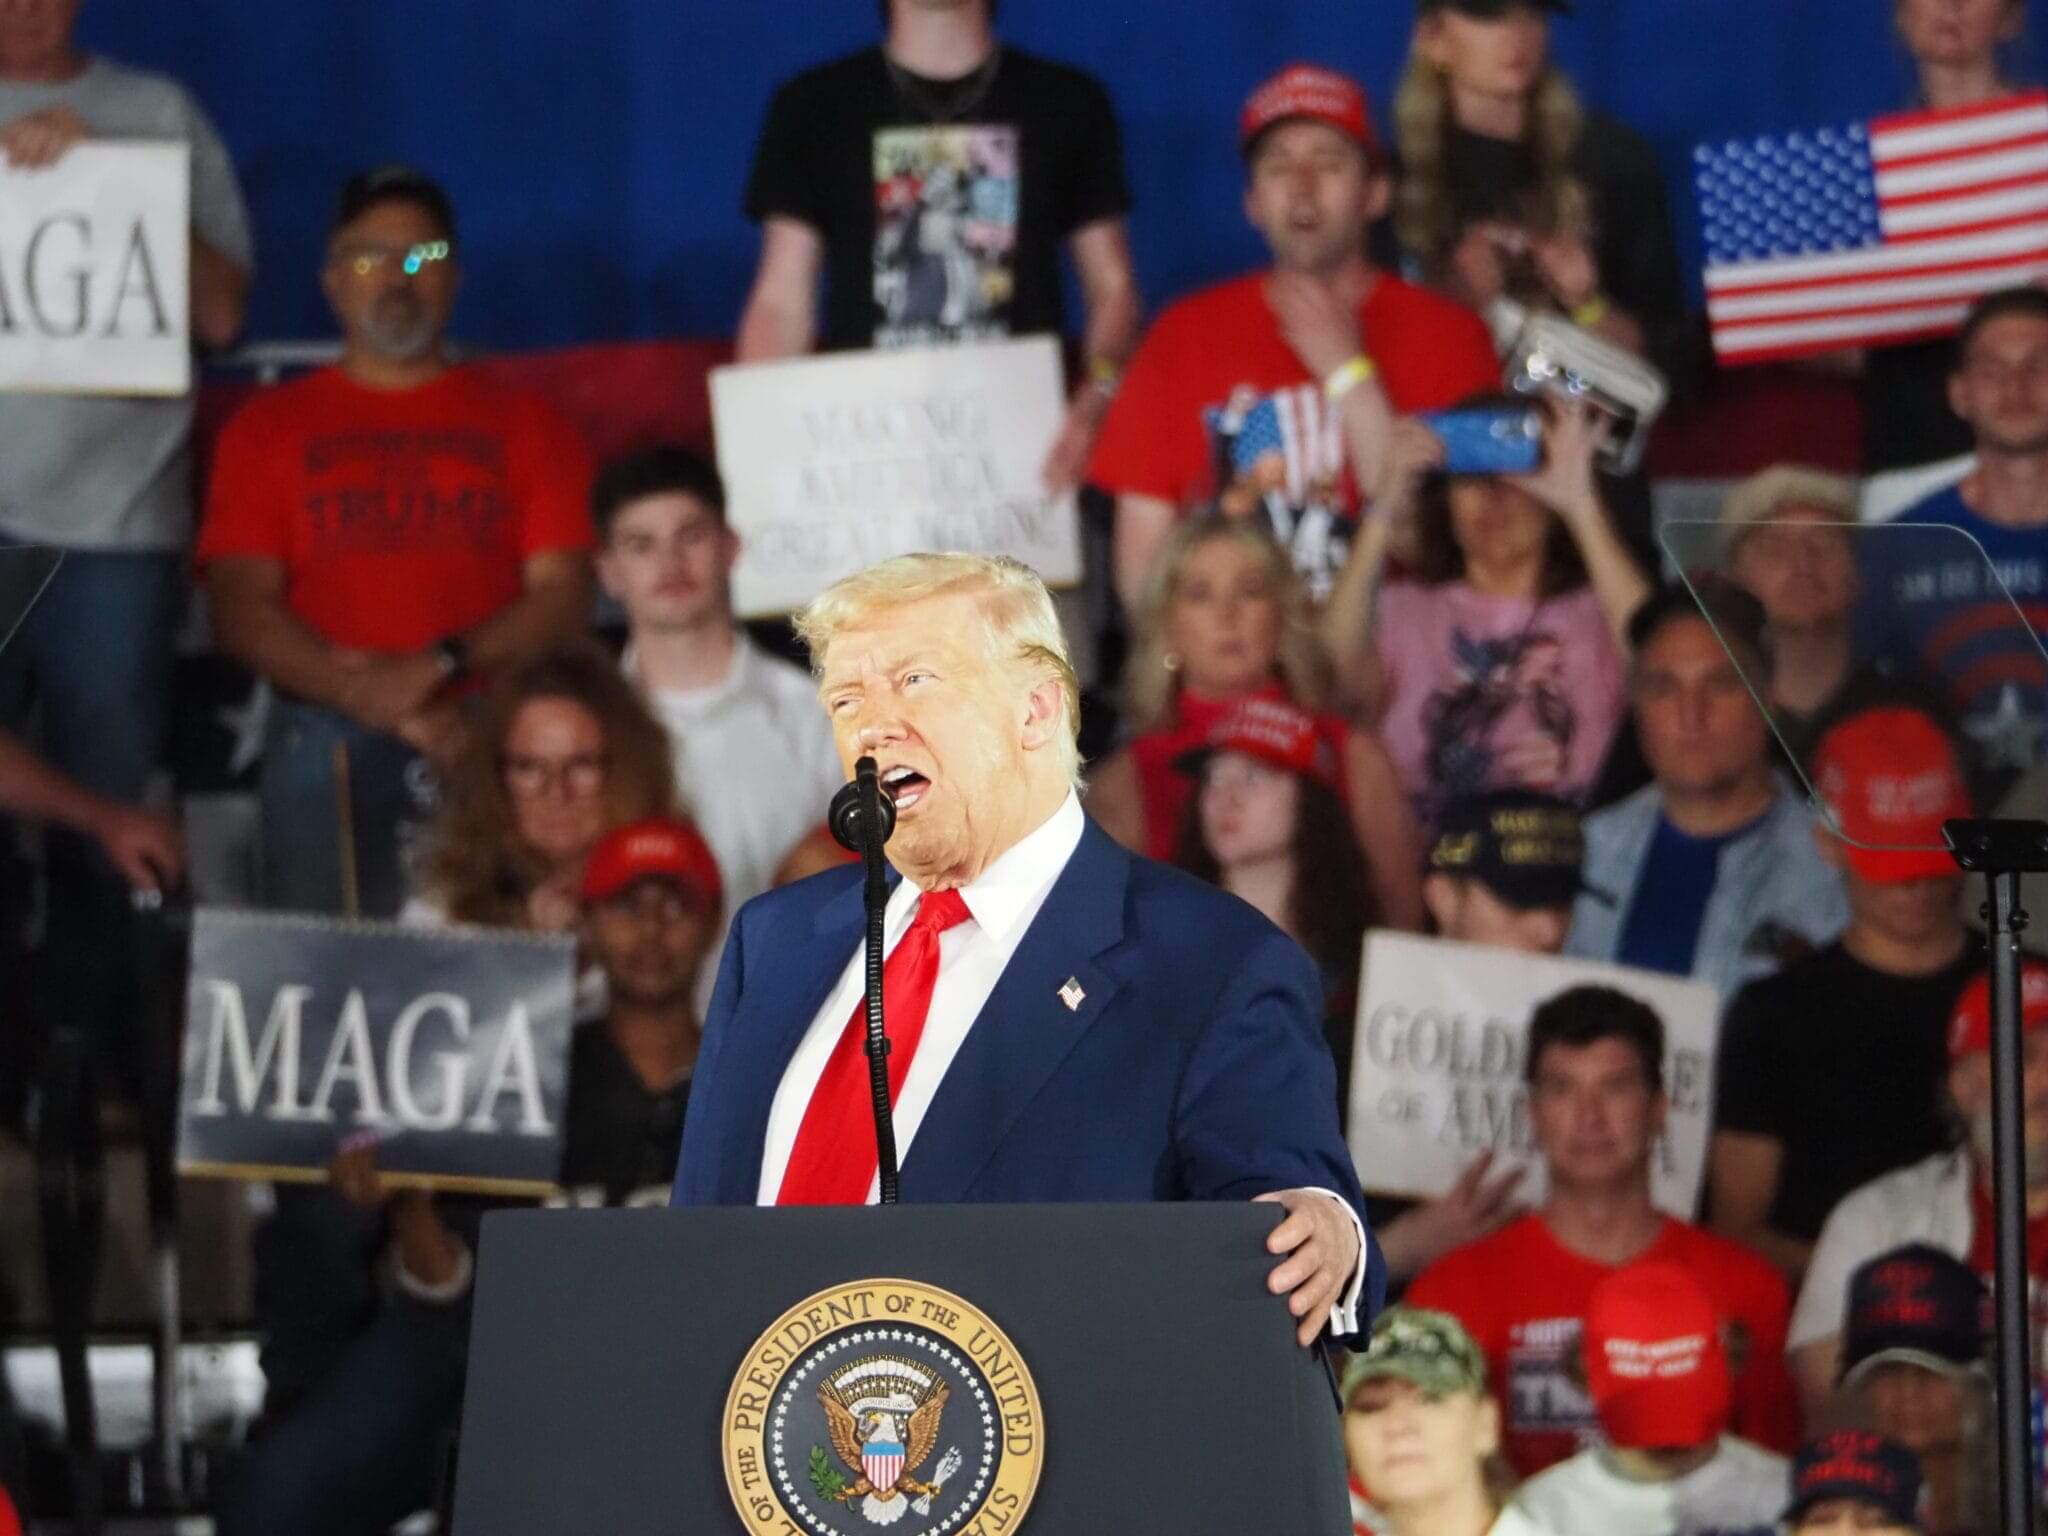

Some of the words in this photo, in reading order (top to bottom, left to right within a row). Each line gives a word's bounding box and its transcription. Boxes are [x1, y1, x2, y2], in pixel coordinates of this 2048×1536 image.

[197, 979, 555, 1138] MAGA
[885, 1294, 915, 1313] OF
[922, 1300, 960, 1331] THE
[734, 1291, 874, 1433] PRESIDENT
[967, 1326, 1034, 1456] UNITED
[737, 1446, 761, 1490] THE
[749, 1494, 775, 1522] OF
